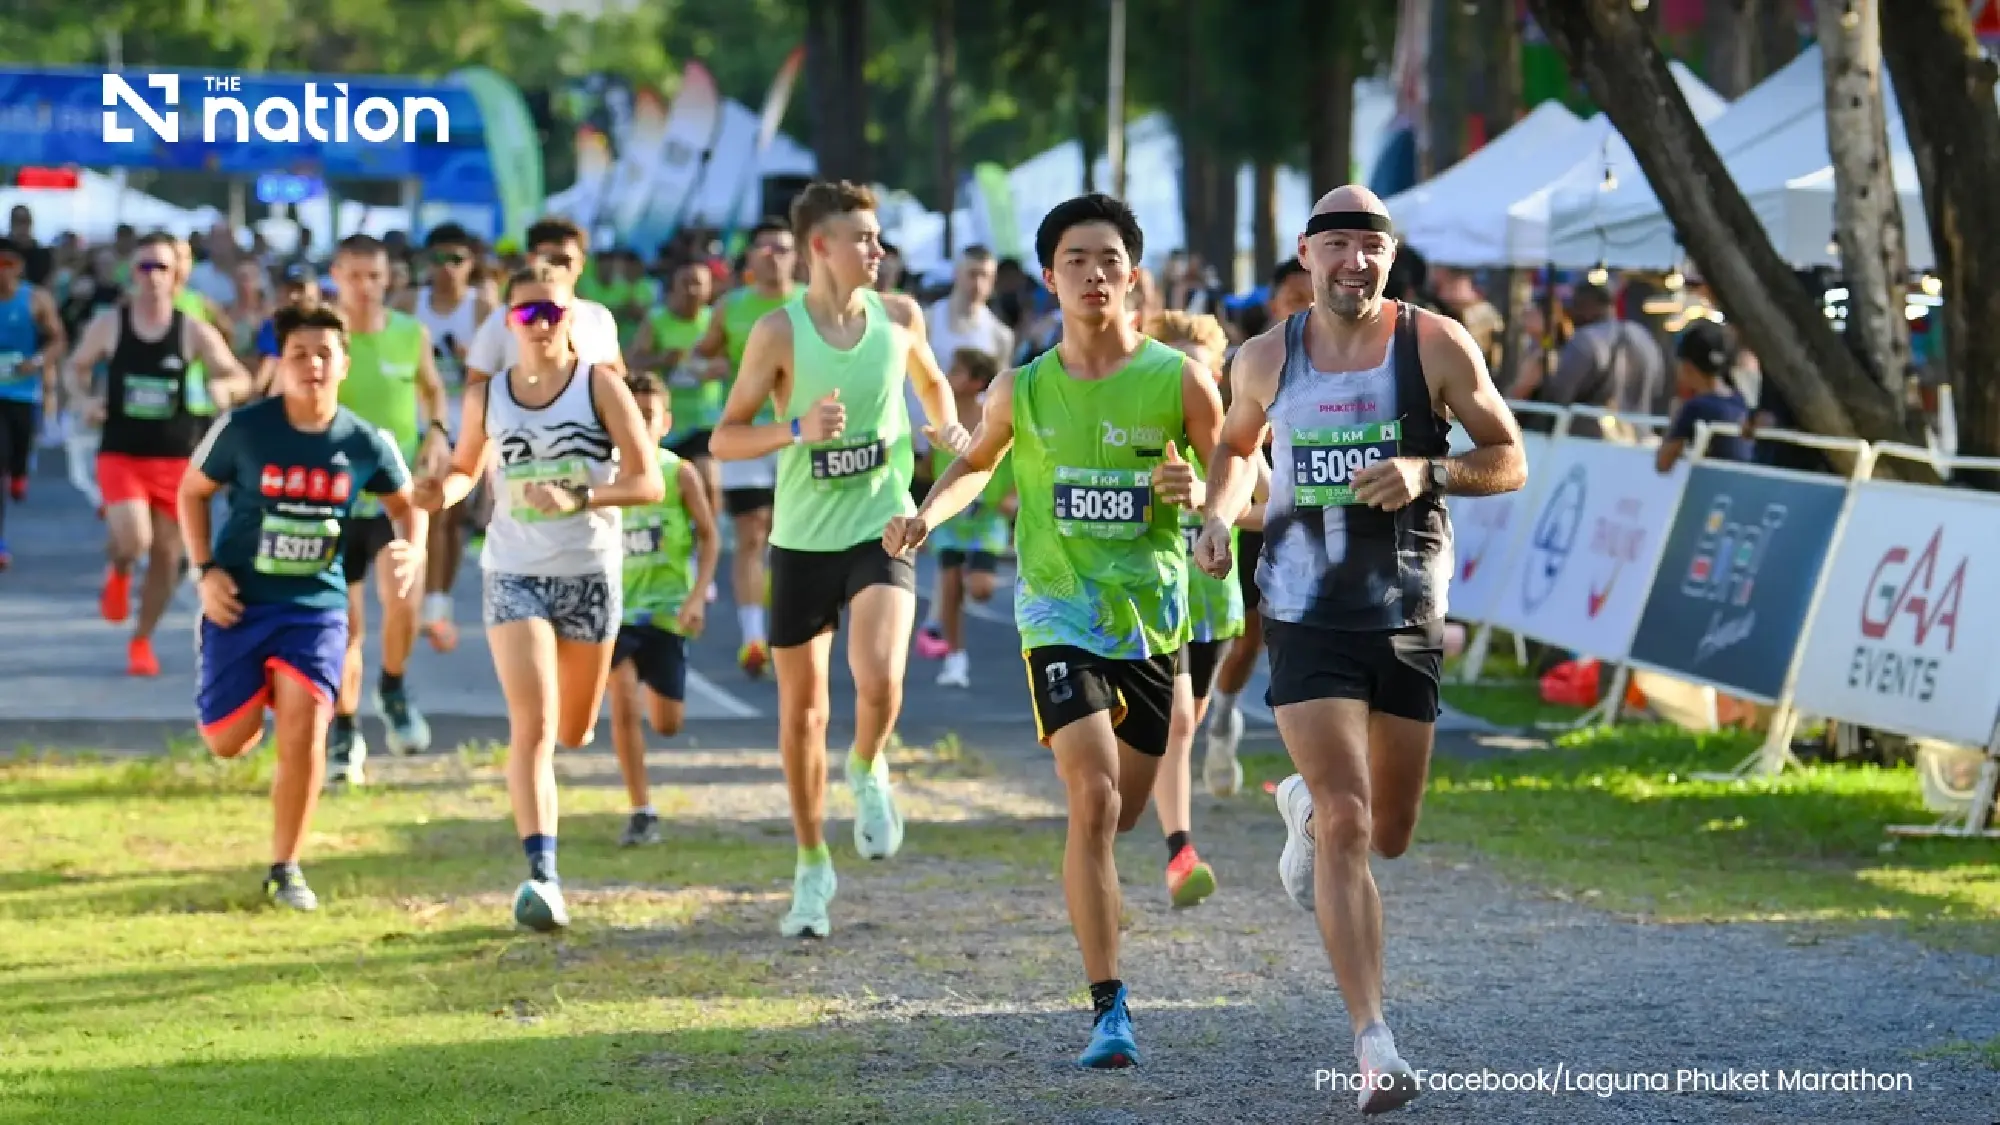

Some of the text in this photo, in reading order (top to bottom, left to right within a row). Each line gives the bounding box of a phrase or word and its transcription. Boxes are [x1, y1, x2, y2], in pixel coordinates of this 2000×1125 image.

[1102, 420, 1127, 446] 20
[1342, 430, 1364, 441] KM
[827, 444, 878, 476] 5007
[1101, 475, 1119, 486] KM
[1071, 488, 1135, 520] 5038
[1861, 522, 1968, 653] GAA
[1849, 646, 1940, 702] EVENTS
